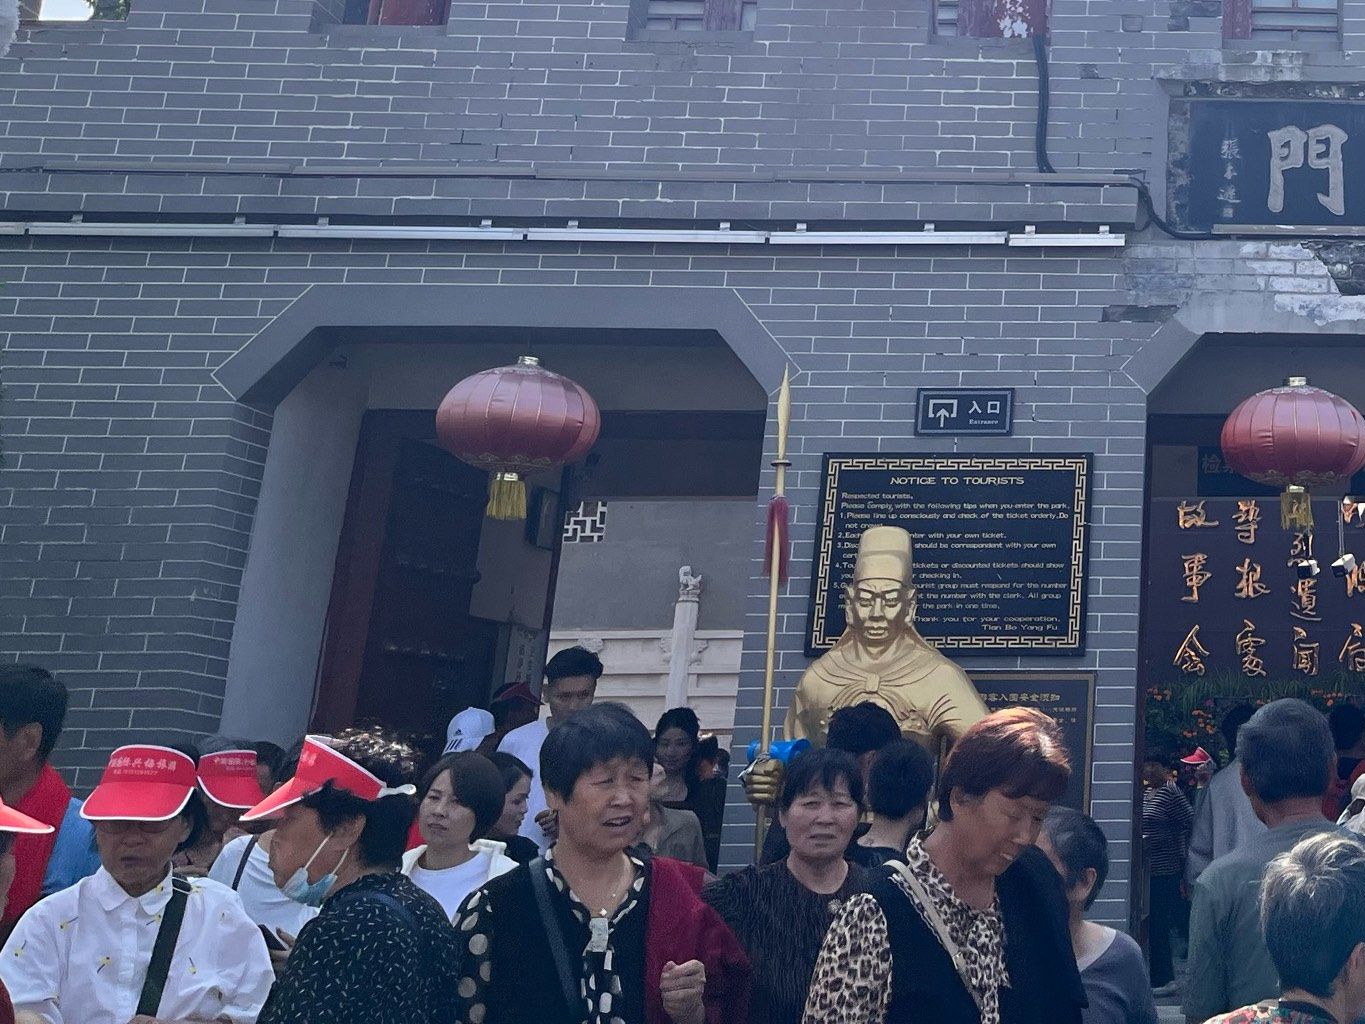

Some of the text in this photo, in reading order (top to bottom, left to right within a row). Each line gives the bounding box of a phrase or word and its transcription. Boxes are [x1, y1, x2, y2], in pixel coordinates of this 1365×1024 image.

[969, 400, 1000, 414] 入口
[890, 476, 1025, 485] NOTICE TO TOURISTS
[841, 492, 879, 500] Respected
[951, 542, 1002, 550] correspondent
[982, 582, 1010, 590] respond
[1021, 624, 1043, 632] Yang
